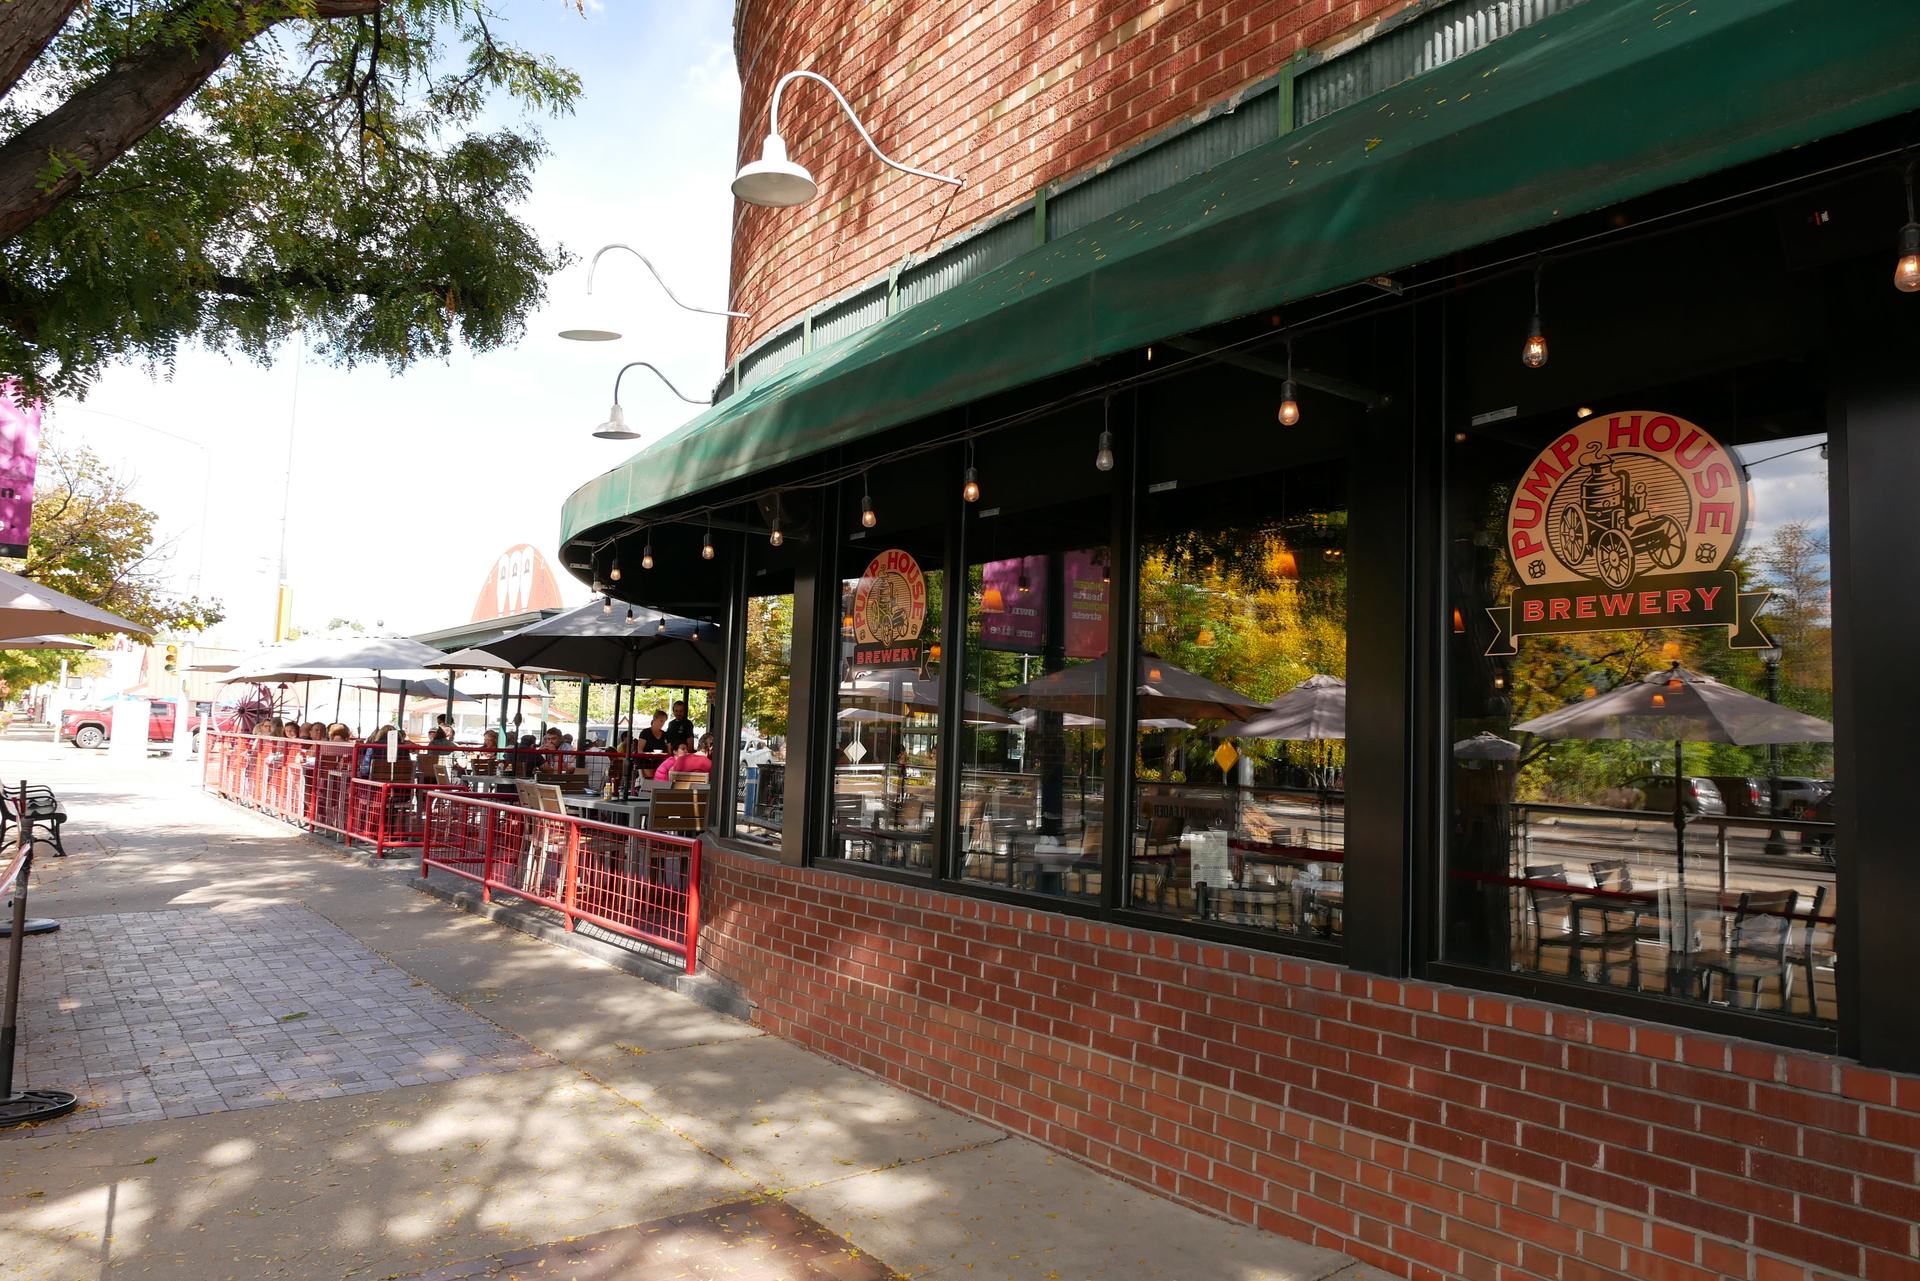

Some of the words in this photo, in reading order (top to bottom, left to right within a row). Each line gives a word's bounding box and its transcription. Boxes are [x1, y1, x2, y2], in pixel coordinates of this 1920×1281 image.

[1511, 433, 1580, 560] PUMP
[1606, 415, 1735, 535] HOUSE
[887, 551, 924, 621] HOUSE
[1523, 586, 1722, 622] BREWERY
[856, 648, 918, 665] BREWERY
